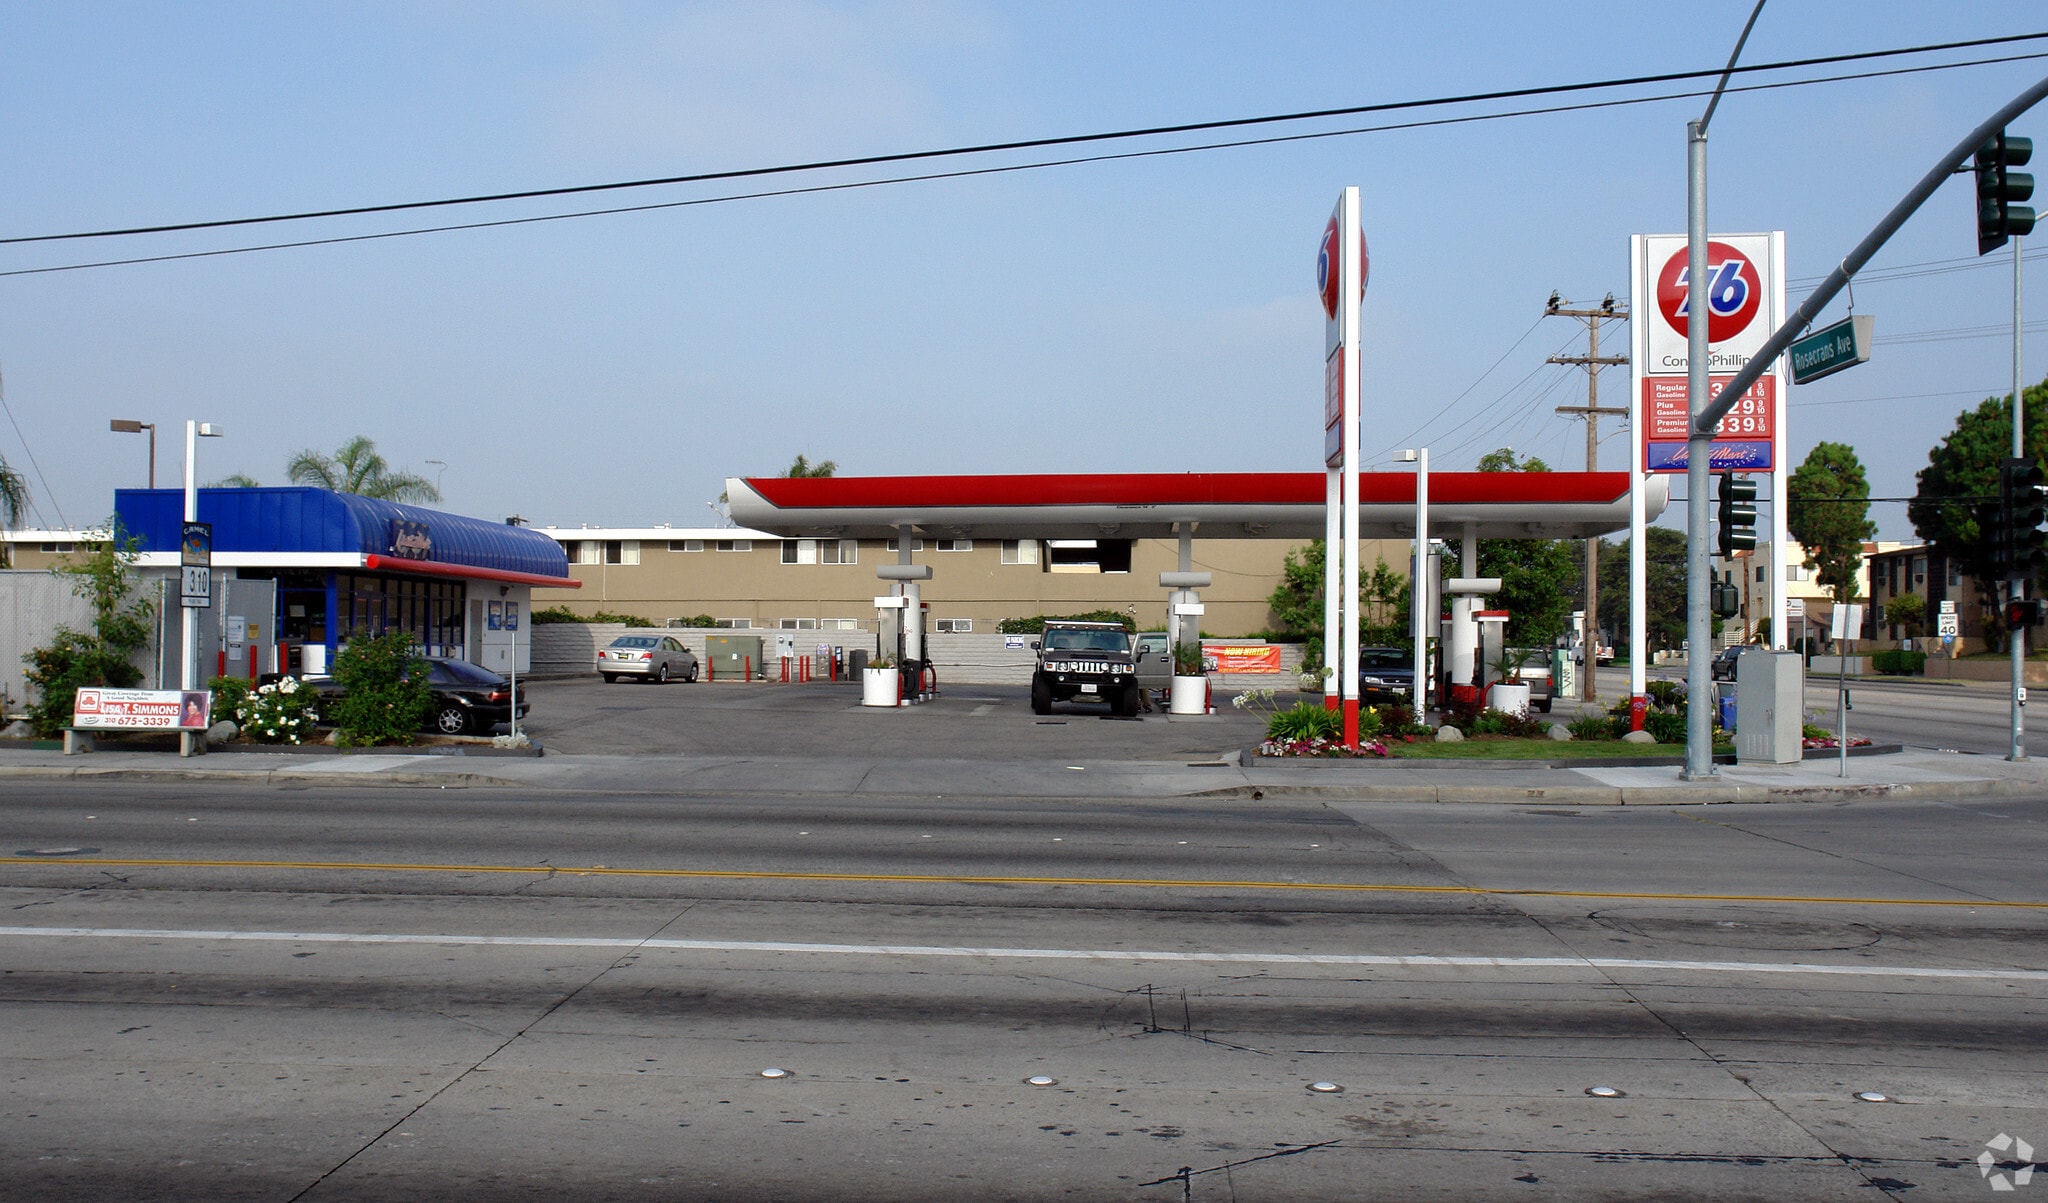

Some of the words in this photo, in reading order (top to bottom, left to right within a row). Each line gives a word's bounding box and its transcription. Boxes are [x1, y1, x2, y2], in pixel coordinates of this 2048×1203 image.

[1795, 343, 1835, 372] Rosecrans
[1837, 335, 1852, 355] Ave
[1655, 384, 1687, 392] Regular
[1711, 382, 1753, 397] 31
[183, 526, 209, 537] CAMEL
[1940, 625, 1956, 634] 40
[1224, 647, 1244, 655] NOW
[1244, 647, 1271, 655] HIRING
[100, 702, 121, 714] LISA
[123, 703, 131, 714] T.
[131, 704, 179, 715] SIMMONS
[118, 717, 170, 726] 675-3339
